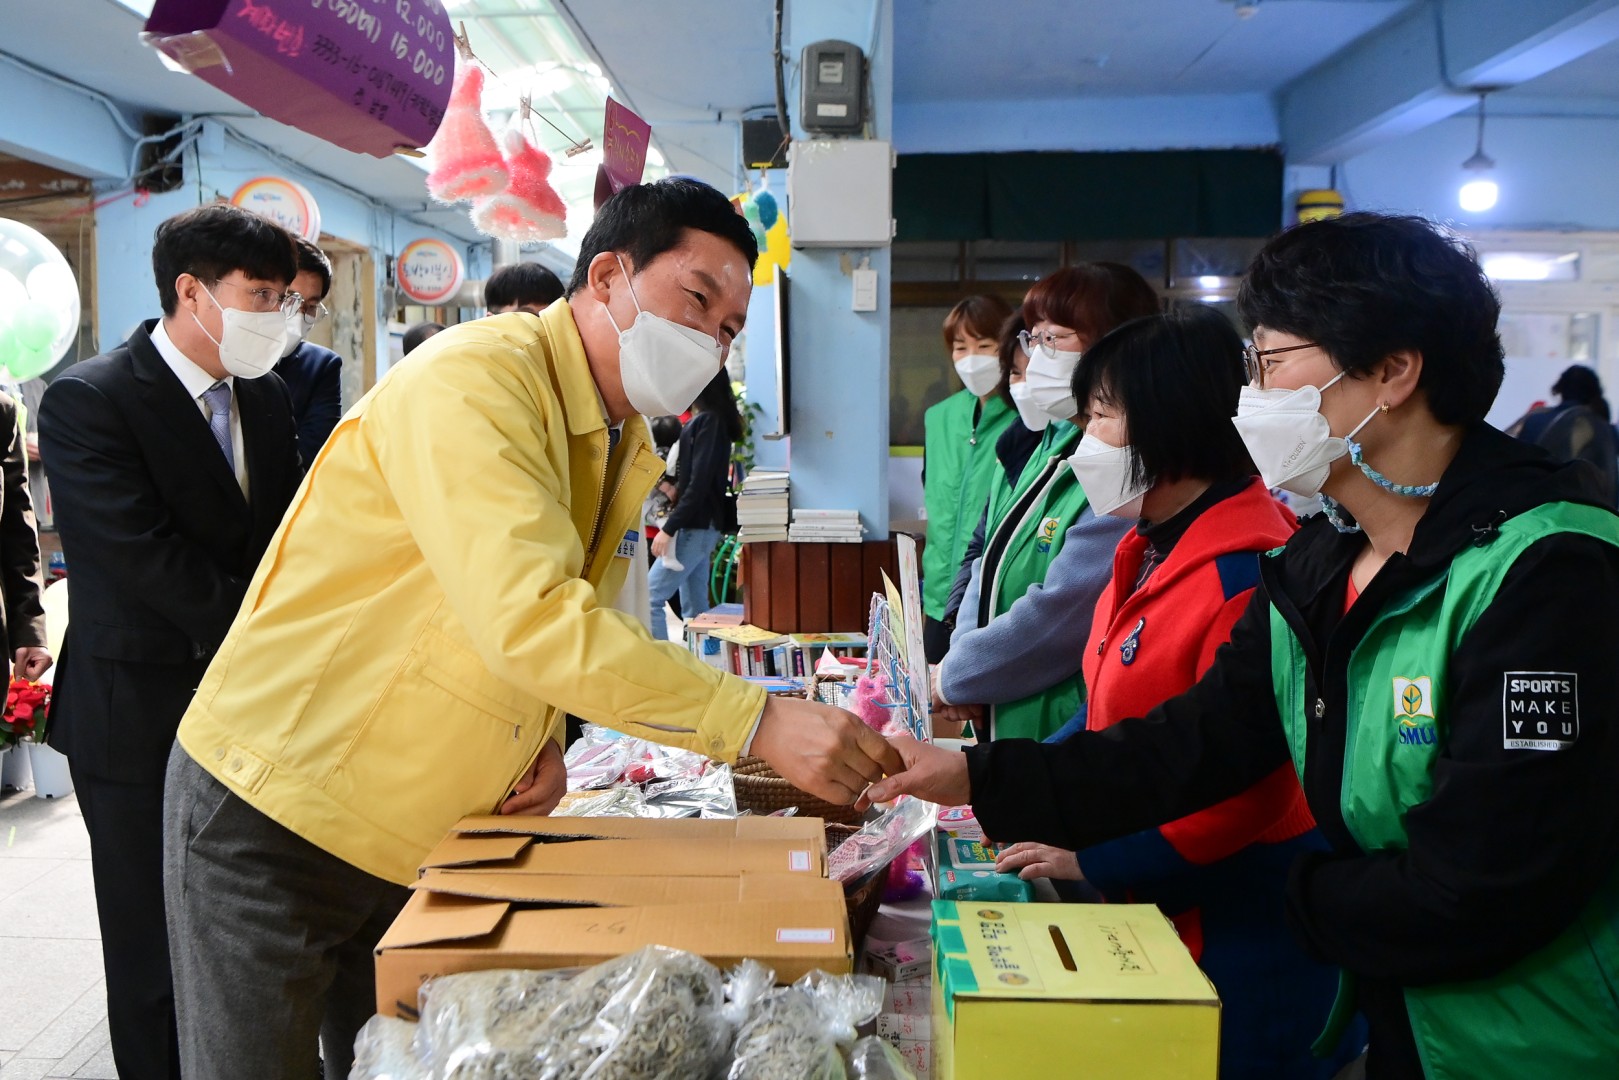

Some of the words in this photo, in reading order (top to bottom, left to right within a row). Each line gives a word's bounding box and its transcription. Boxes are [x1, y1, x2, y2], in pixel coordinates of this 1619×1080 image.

[390, 30, 446, 86] 15.000
[1510, 679, 1570, 694] SPORTS
[1510, 700, 1572, 715] MAKE
[1511, 720, 1572, 736] YOU
[1398, 727, 1437, 746] SMU
[1510, 739, 1558, 749] ESTABLISHED
